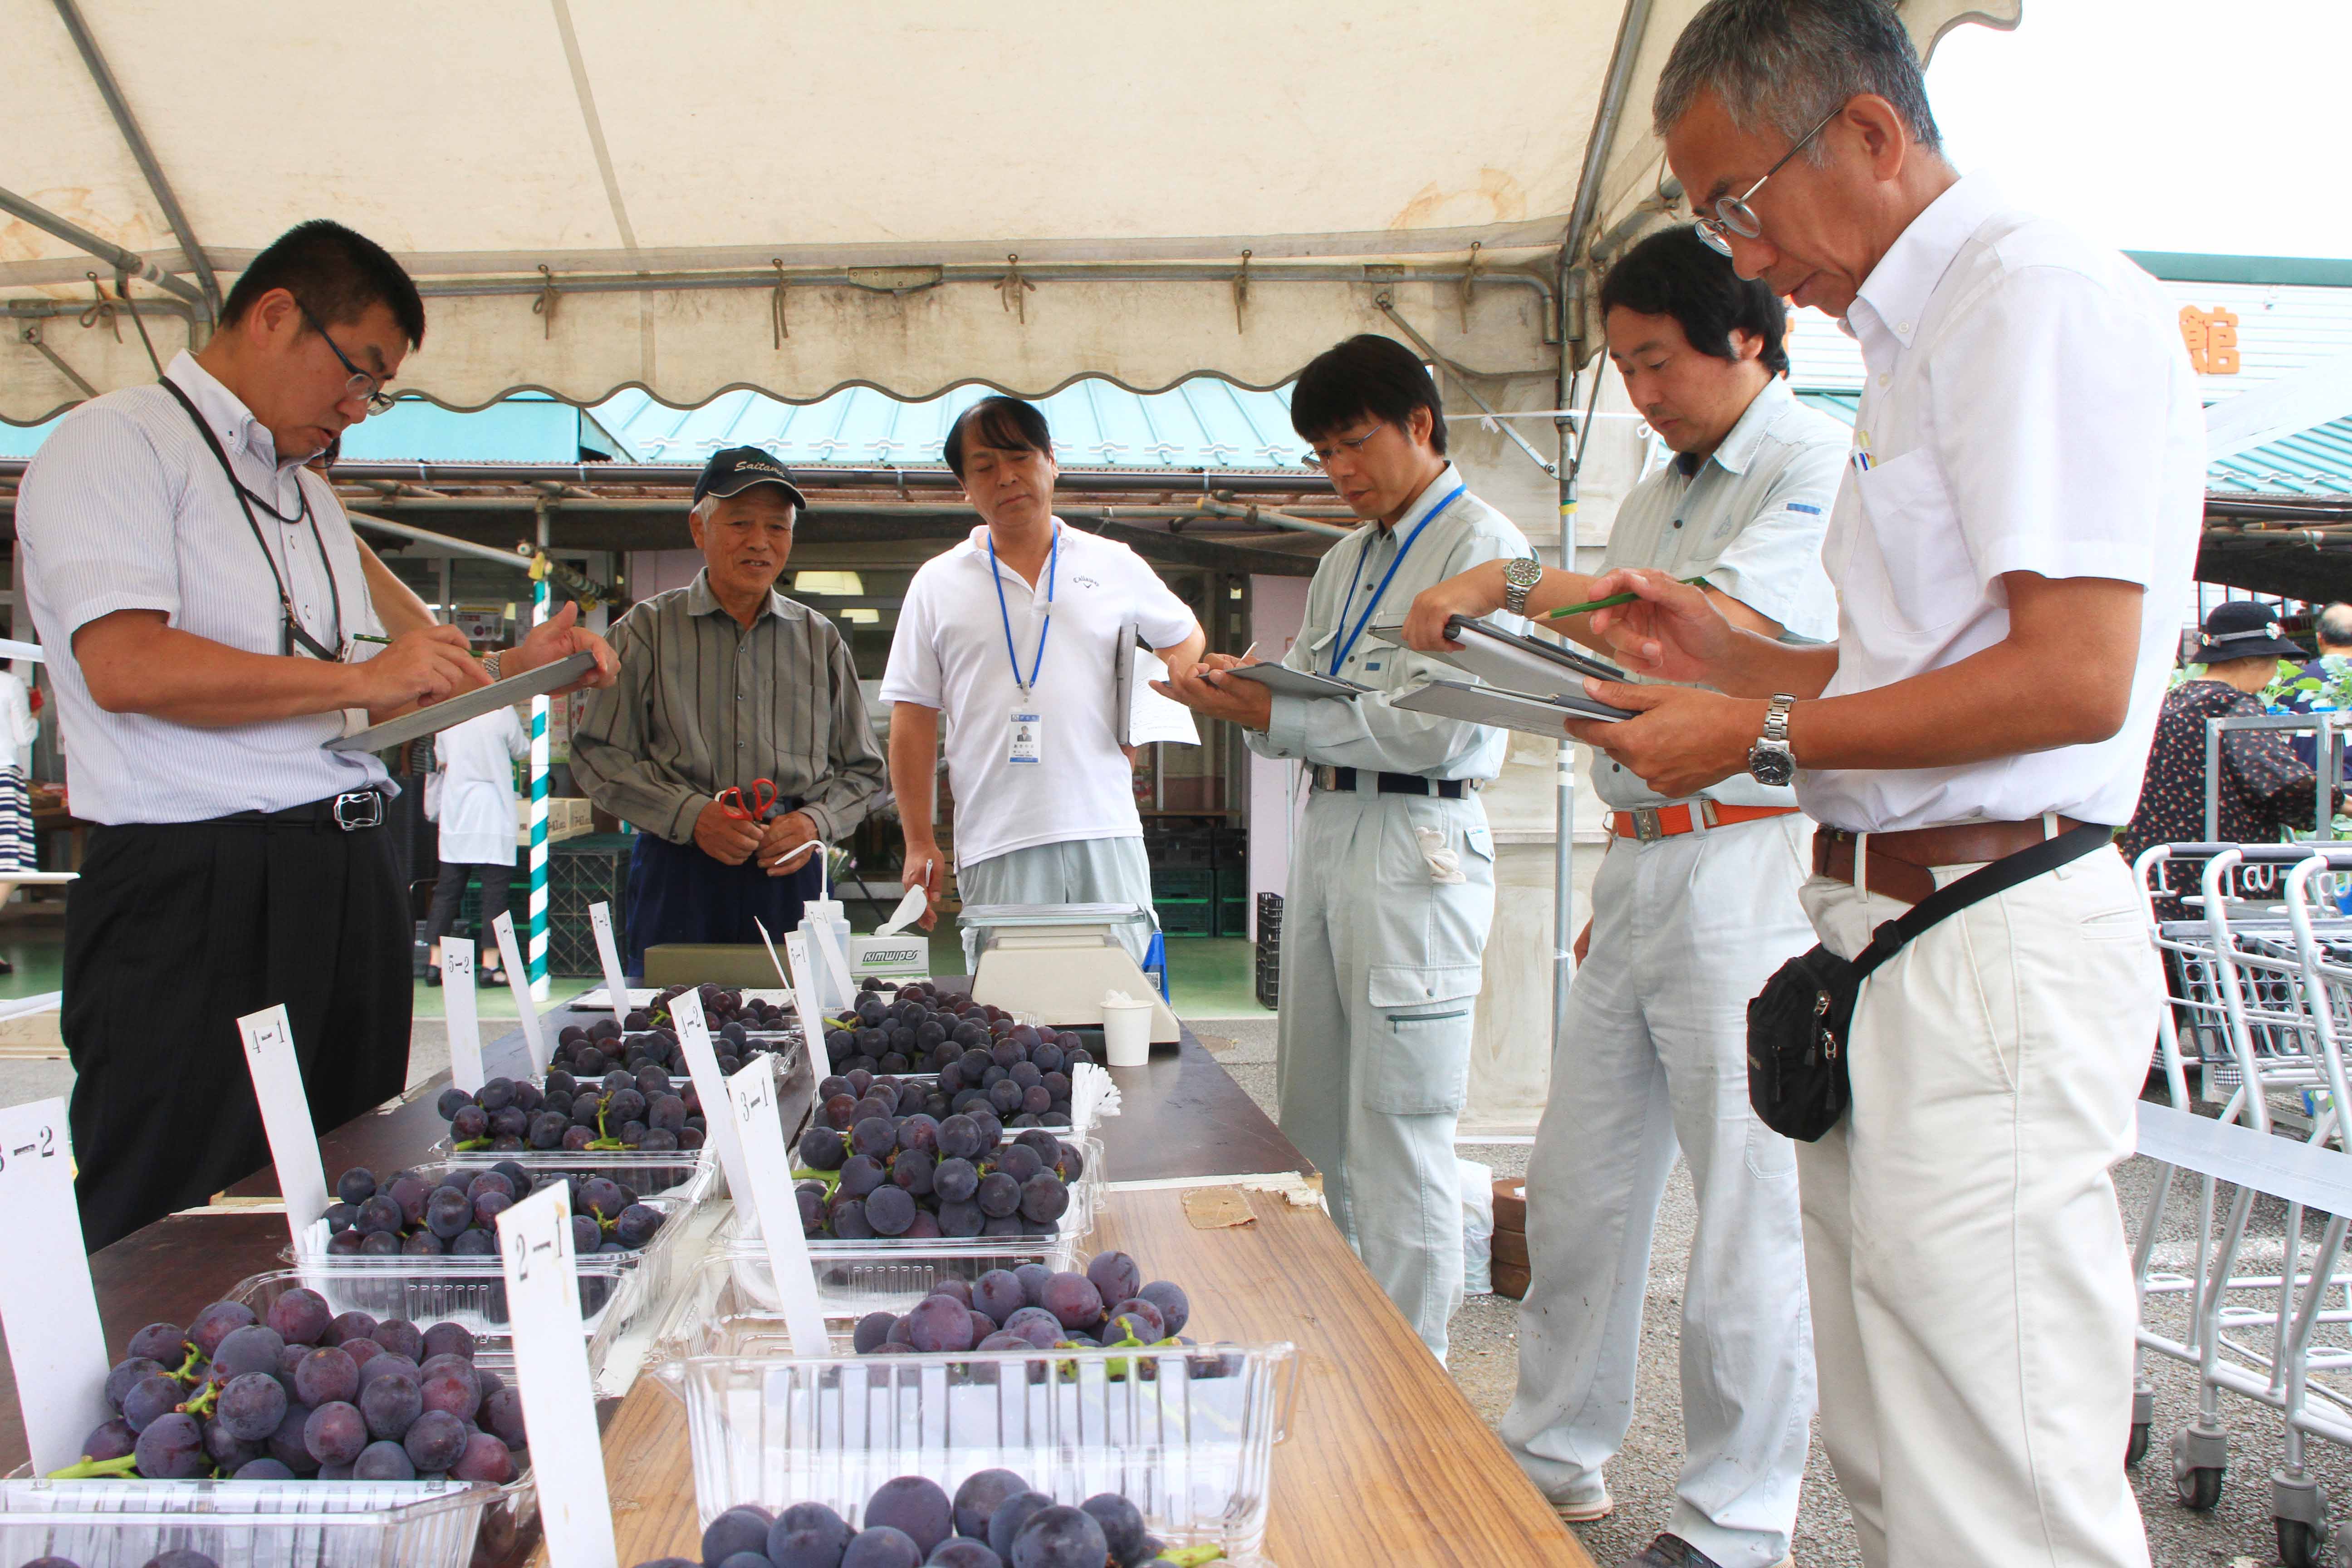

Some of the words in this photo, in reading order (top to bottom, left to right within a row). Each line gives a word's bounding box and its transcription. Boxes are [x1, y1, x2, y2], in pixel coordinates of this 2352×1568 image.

[734, 461, 785, 478] Saitama
[449, 955, 470, 974] 5-2
[252, 1019, 285, 1054] 4-1
[681, 1004, 702, 1039] 4-2
[740, 1077, 769, 1122] 3-1
[515, 1214, 564, 1282] 2-1
